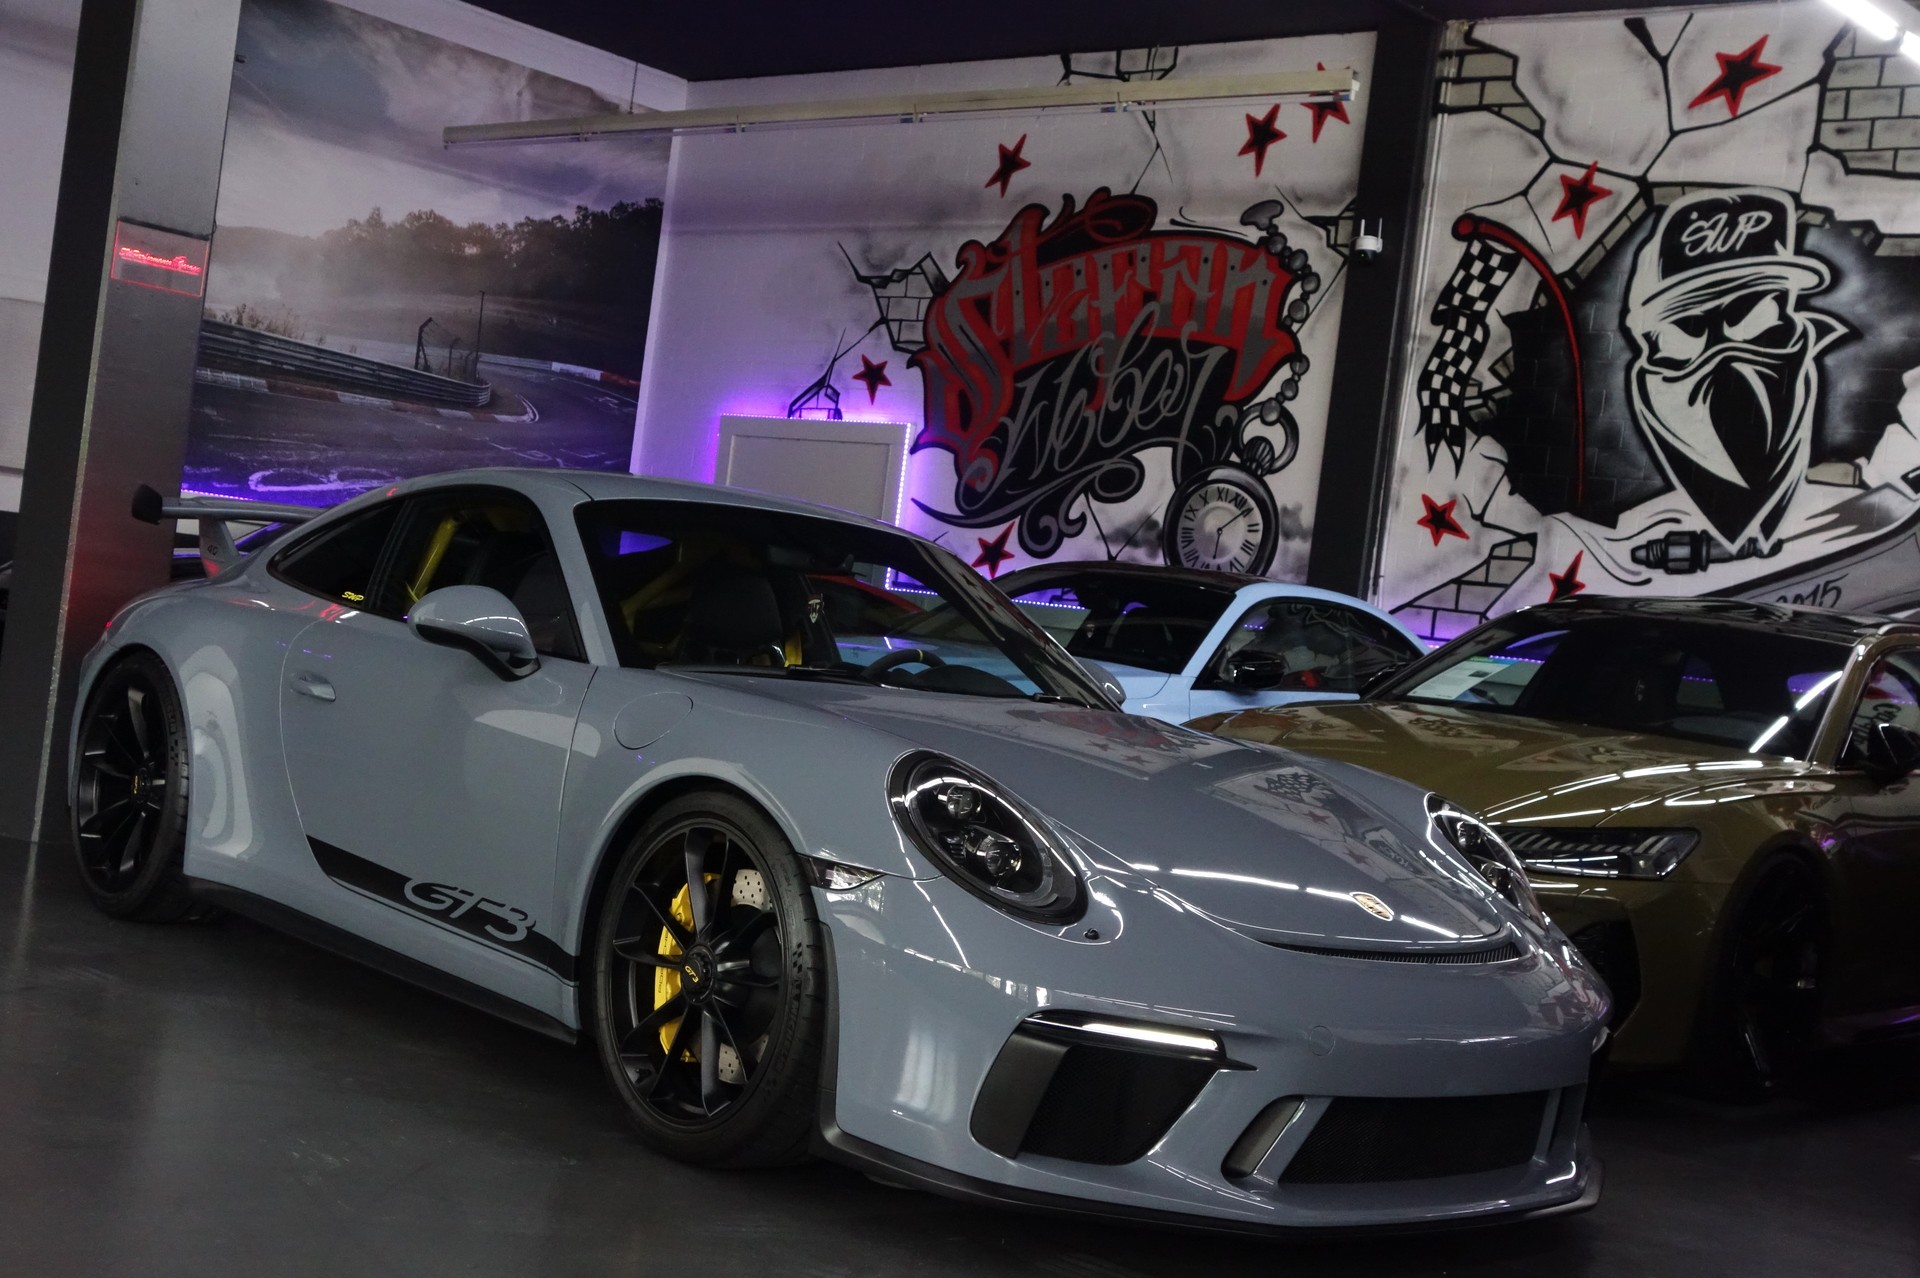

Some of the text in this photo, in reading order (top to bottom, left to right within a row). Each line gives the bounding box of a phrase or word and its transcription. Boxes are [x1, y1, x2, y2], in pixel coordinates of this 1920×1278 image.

[1775, 573, 1849, 609] 15
[403, 878, 537, 943] GT3
[684, 965, 699, 983] GT3
